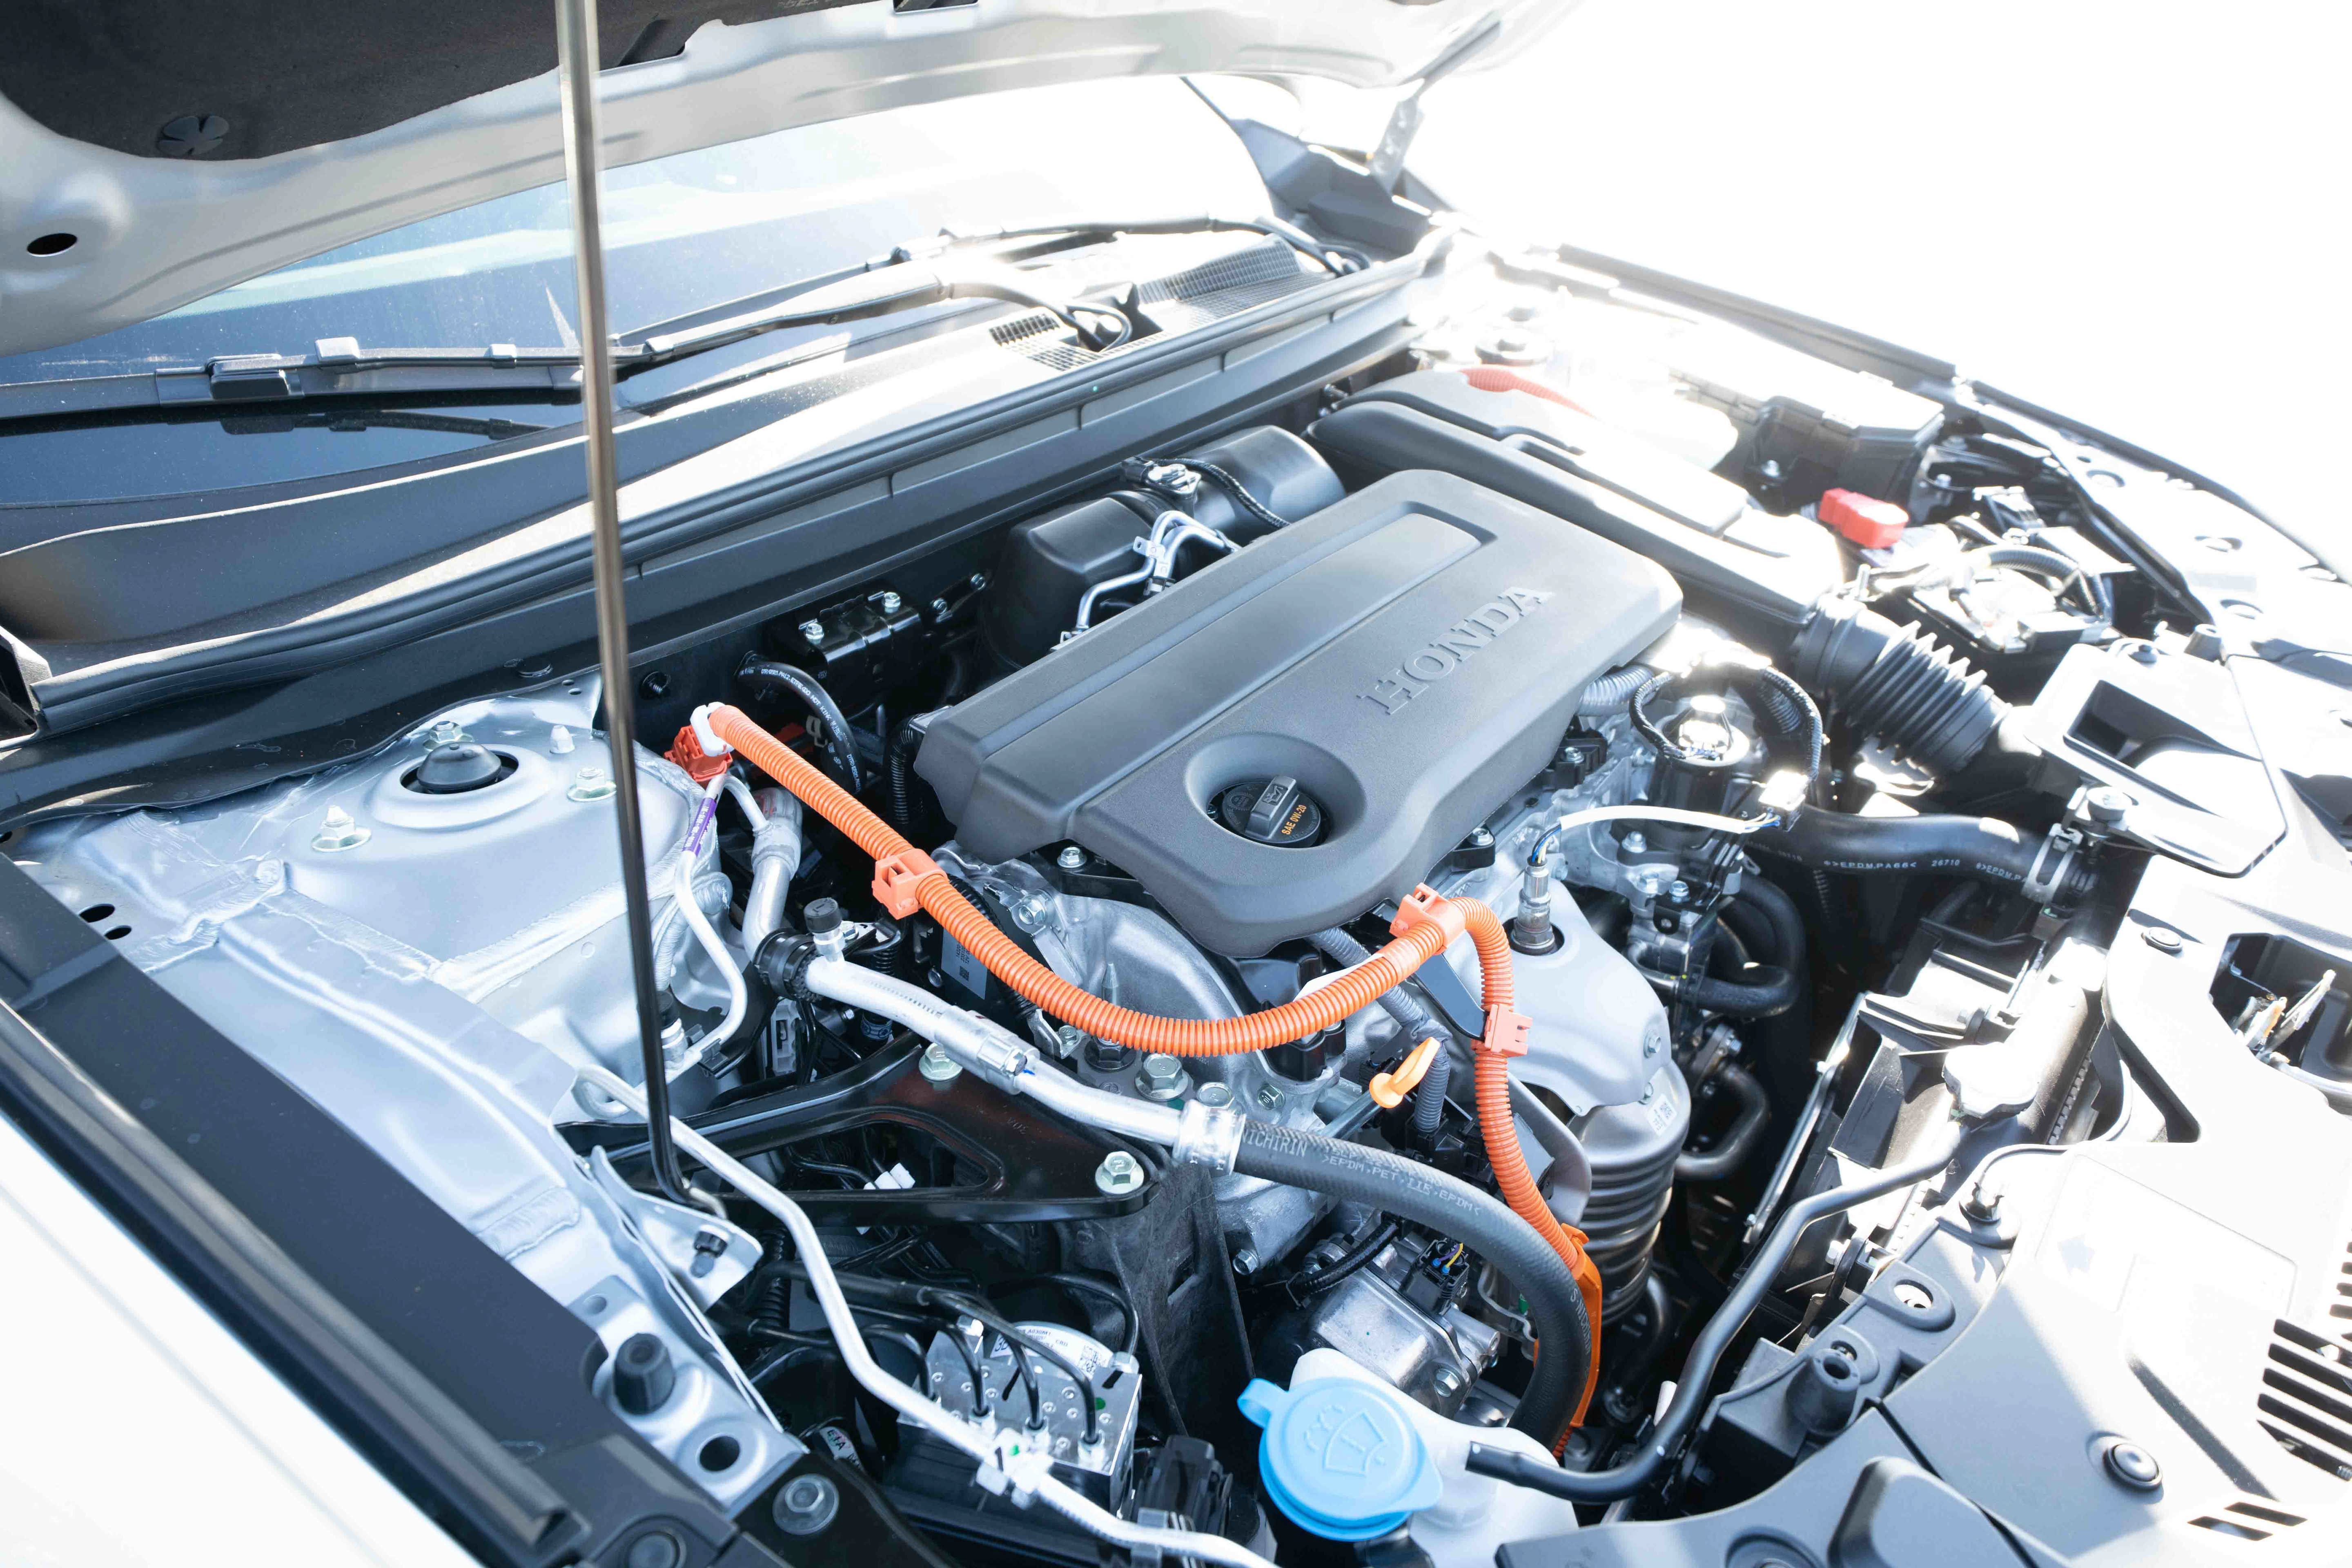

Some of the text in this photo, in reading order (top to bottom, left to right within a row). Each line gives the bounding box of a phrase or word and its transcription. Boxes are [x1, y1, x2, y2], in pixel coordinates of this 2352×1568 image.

[1356, 586, 1555, 715] HONDA
[811, 695, 821, 705] NOT
[820, 706, 832, 721] KINK
[1281, 822, 1296, 835] SAE
[1290, 804, 1307, 822] 0W-20
